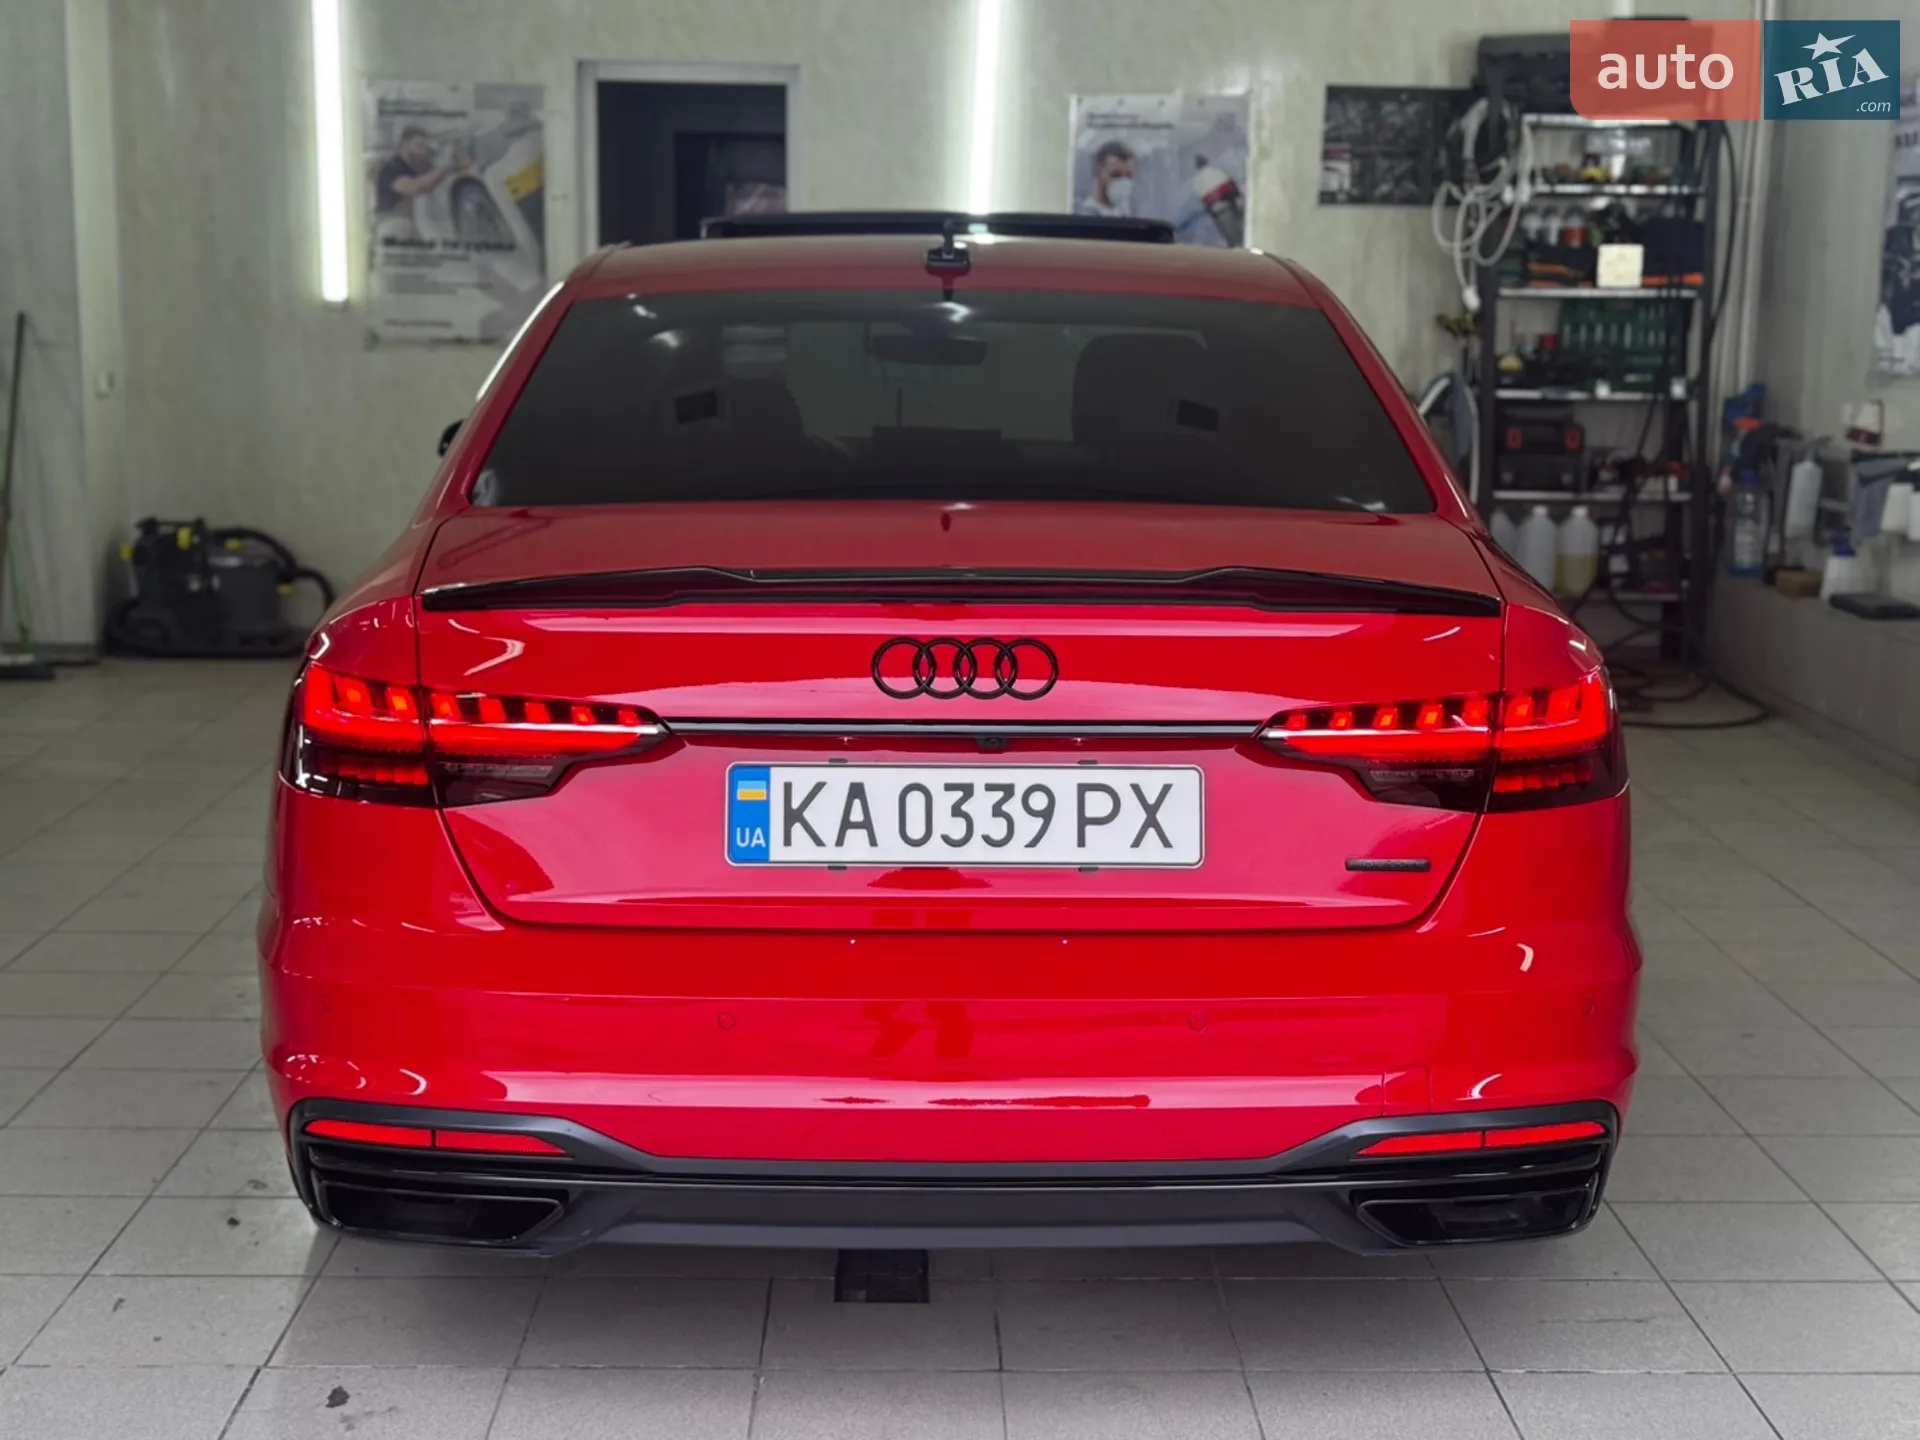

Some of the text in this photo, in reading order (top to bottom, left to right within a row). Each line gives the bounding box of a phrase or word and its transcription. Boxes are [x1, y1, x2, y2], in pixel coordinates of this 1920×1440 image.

[783, 781, 1174, 849] KA 0339 PX
[736, 827, 766, 848] UA
